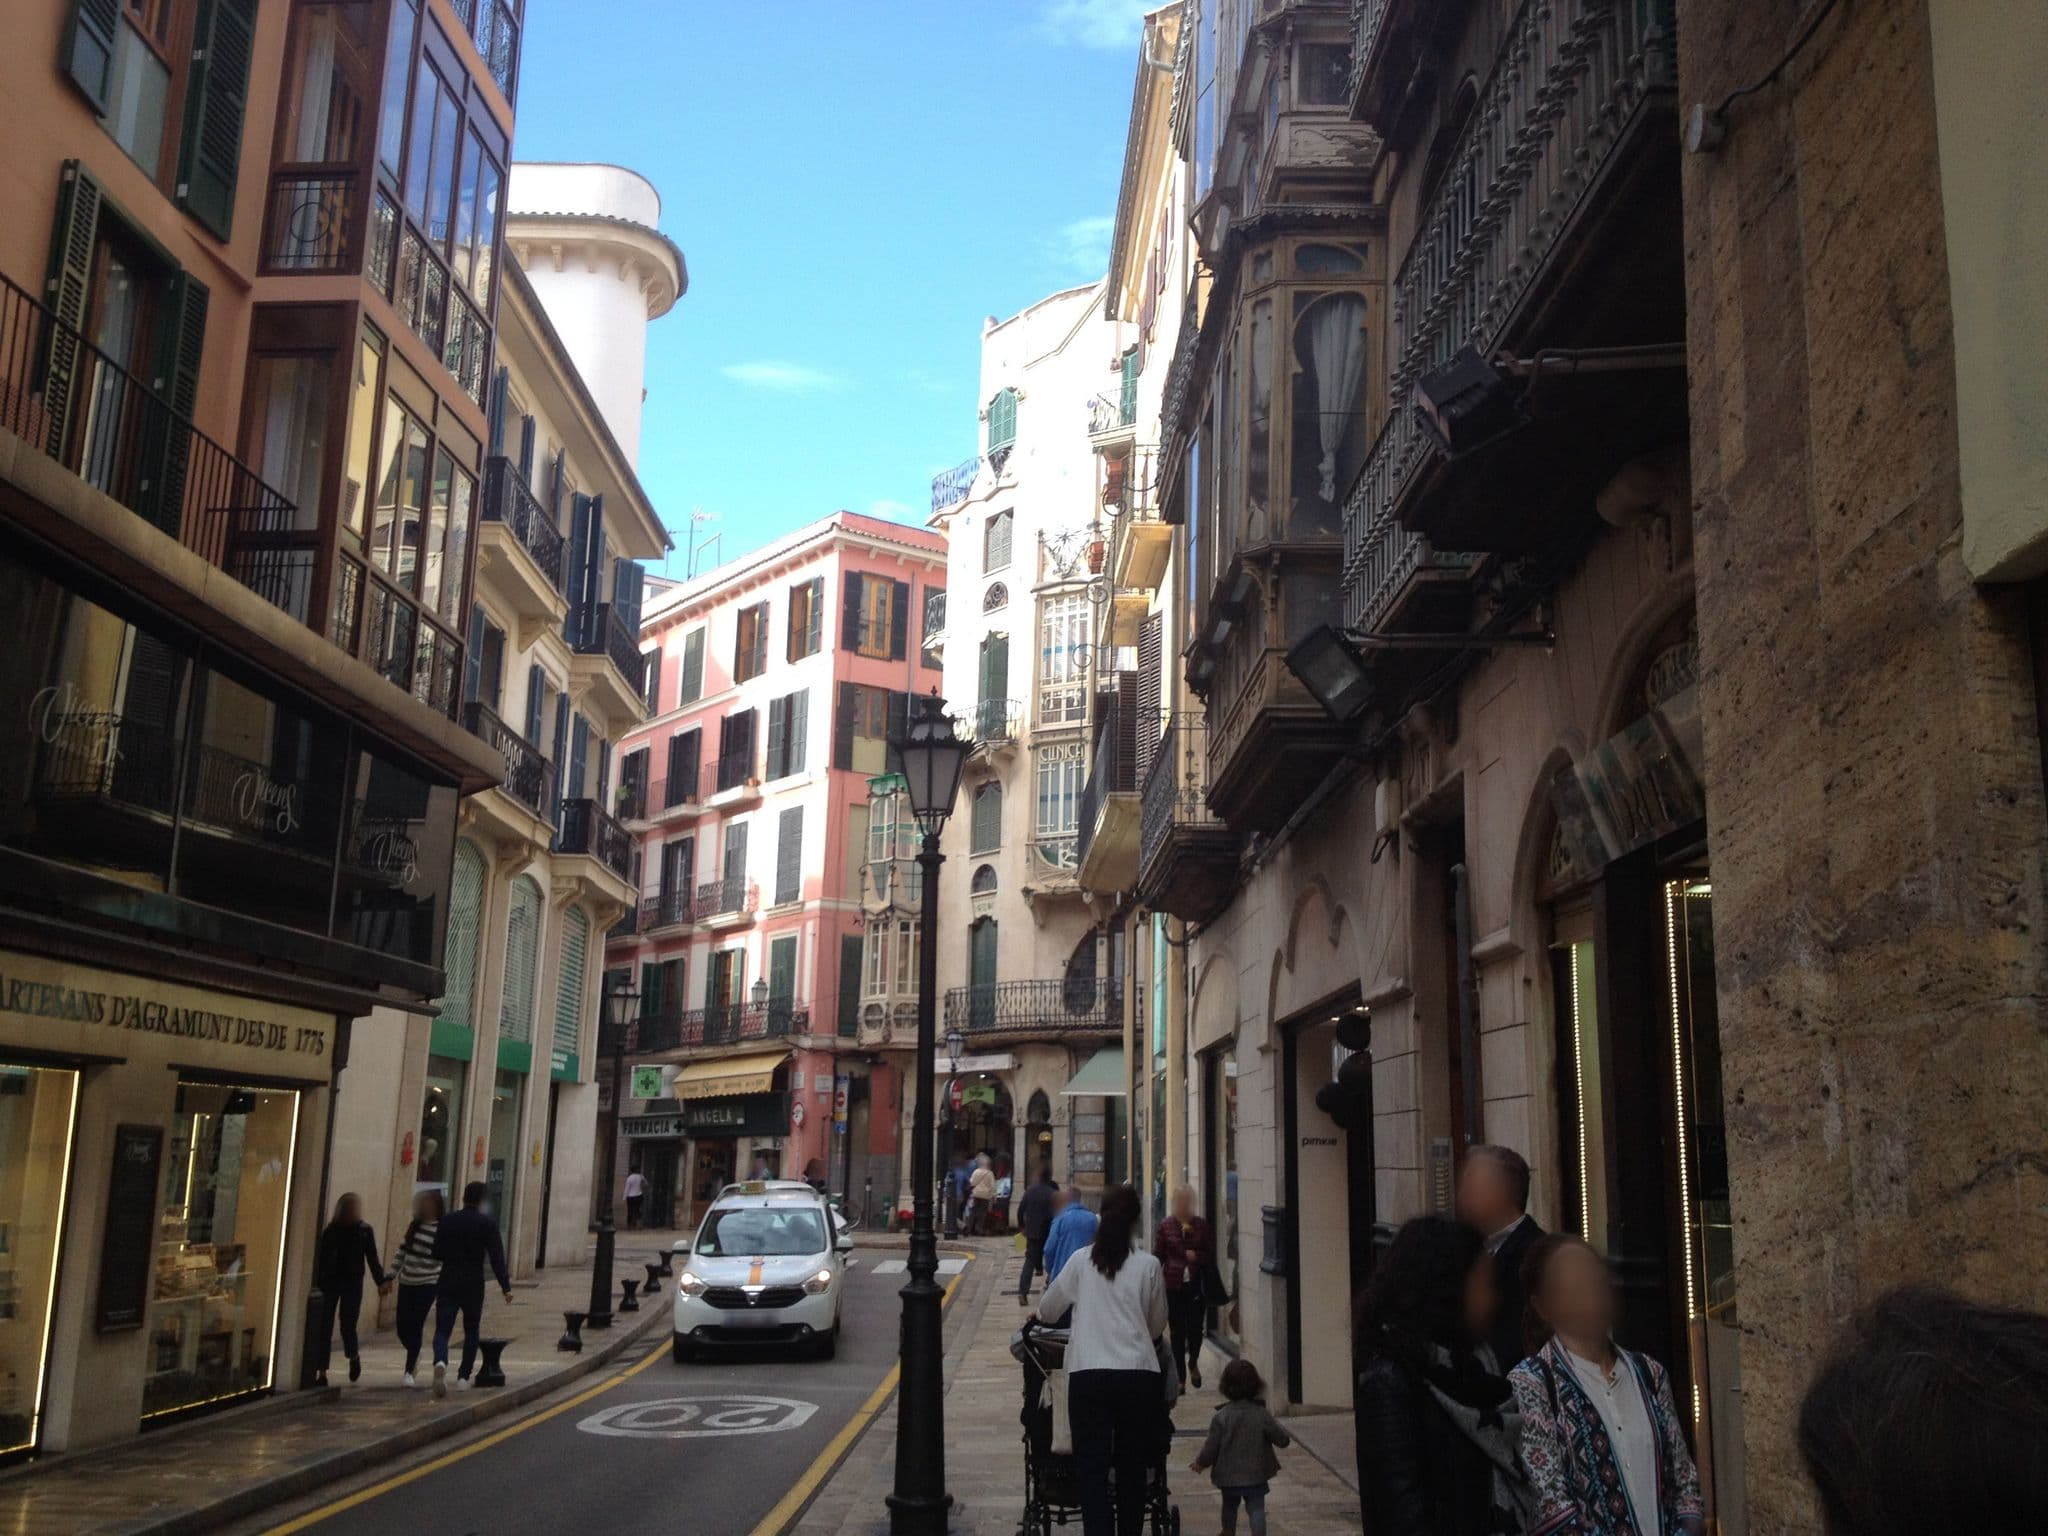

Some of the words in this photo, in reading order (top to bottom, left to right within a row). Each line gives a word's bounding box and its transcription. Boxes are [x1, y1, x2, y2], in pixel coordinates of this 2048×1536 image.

[1040, 743, 1085, 762] CLINICA
[109, 996, 234, 1044] D'AGRAMUNT
[295, 1027, 325, 1056] 1775
[623, 1119, 670, 1136] FARMACIA
[611, 1404, 779, 1428] 20
